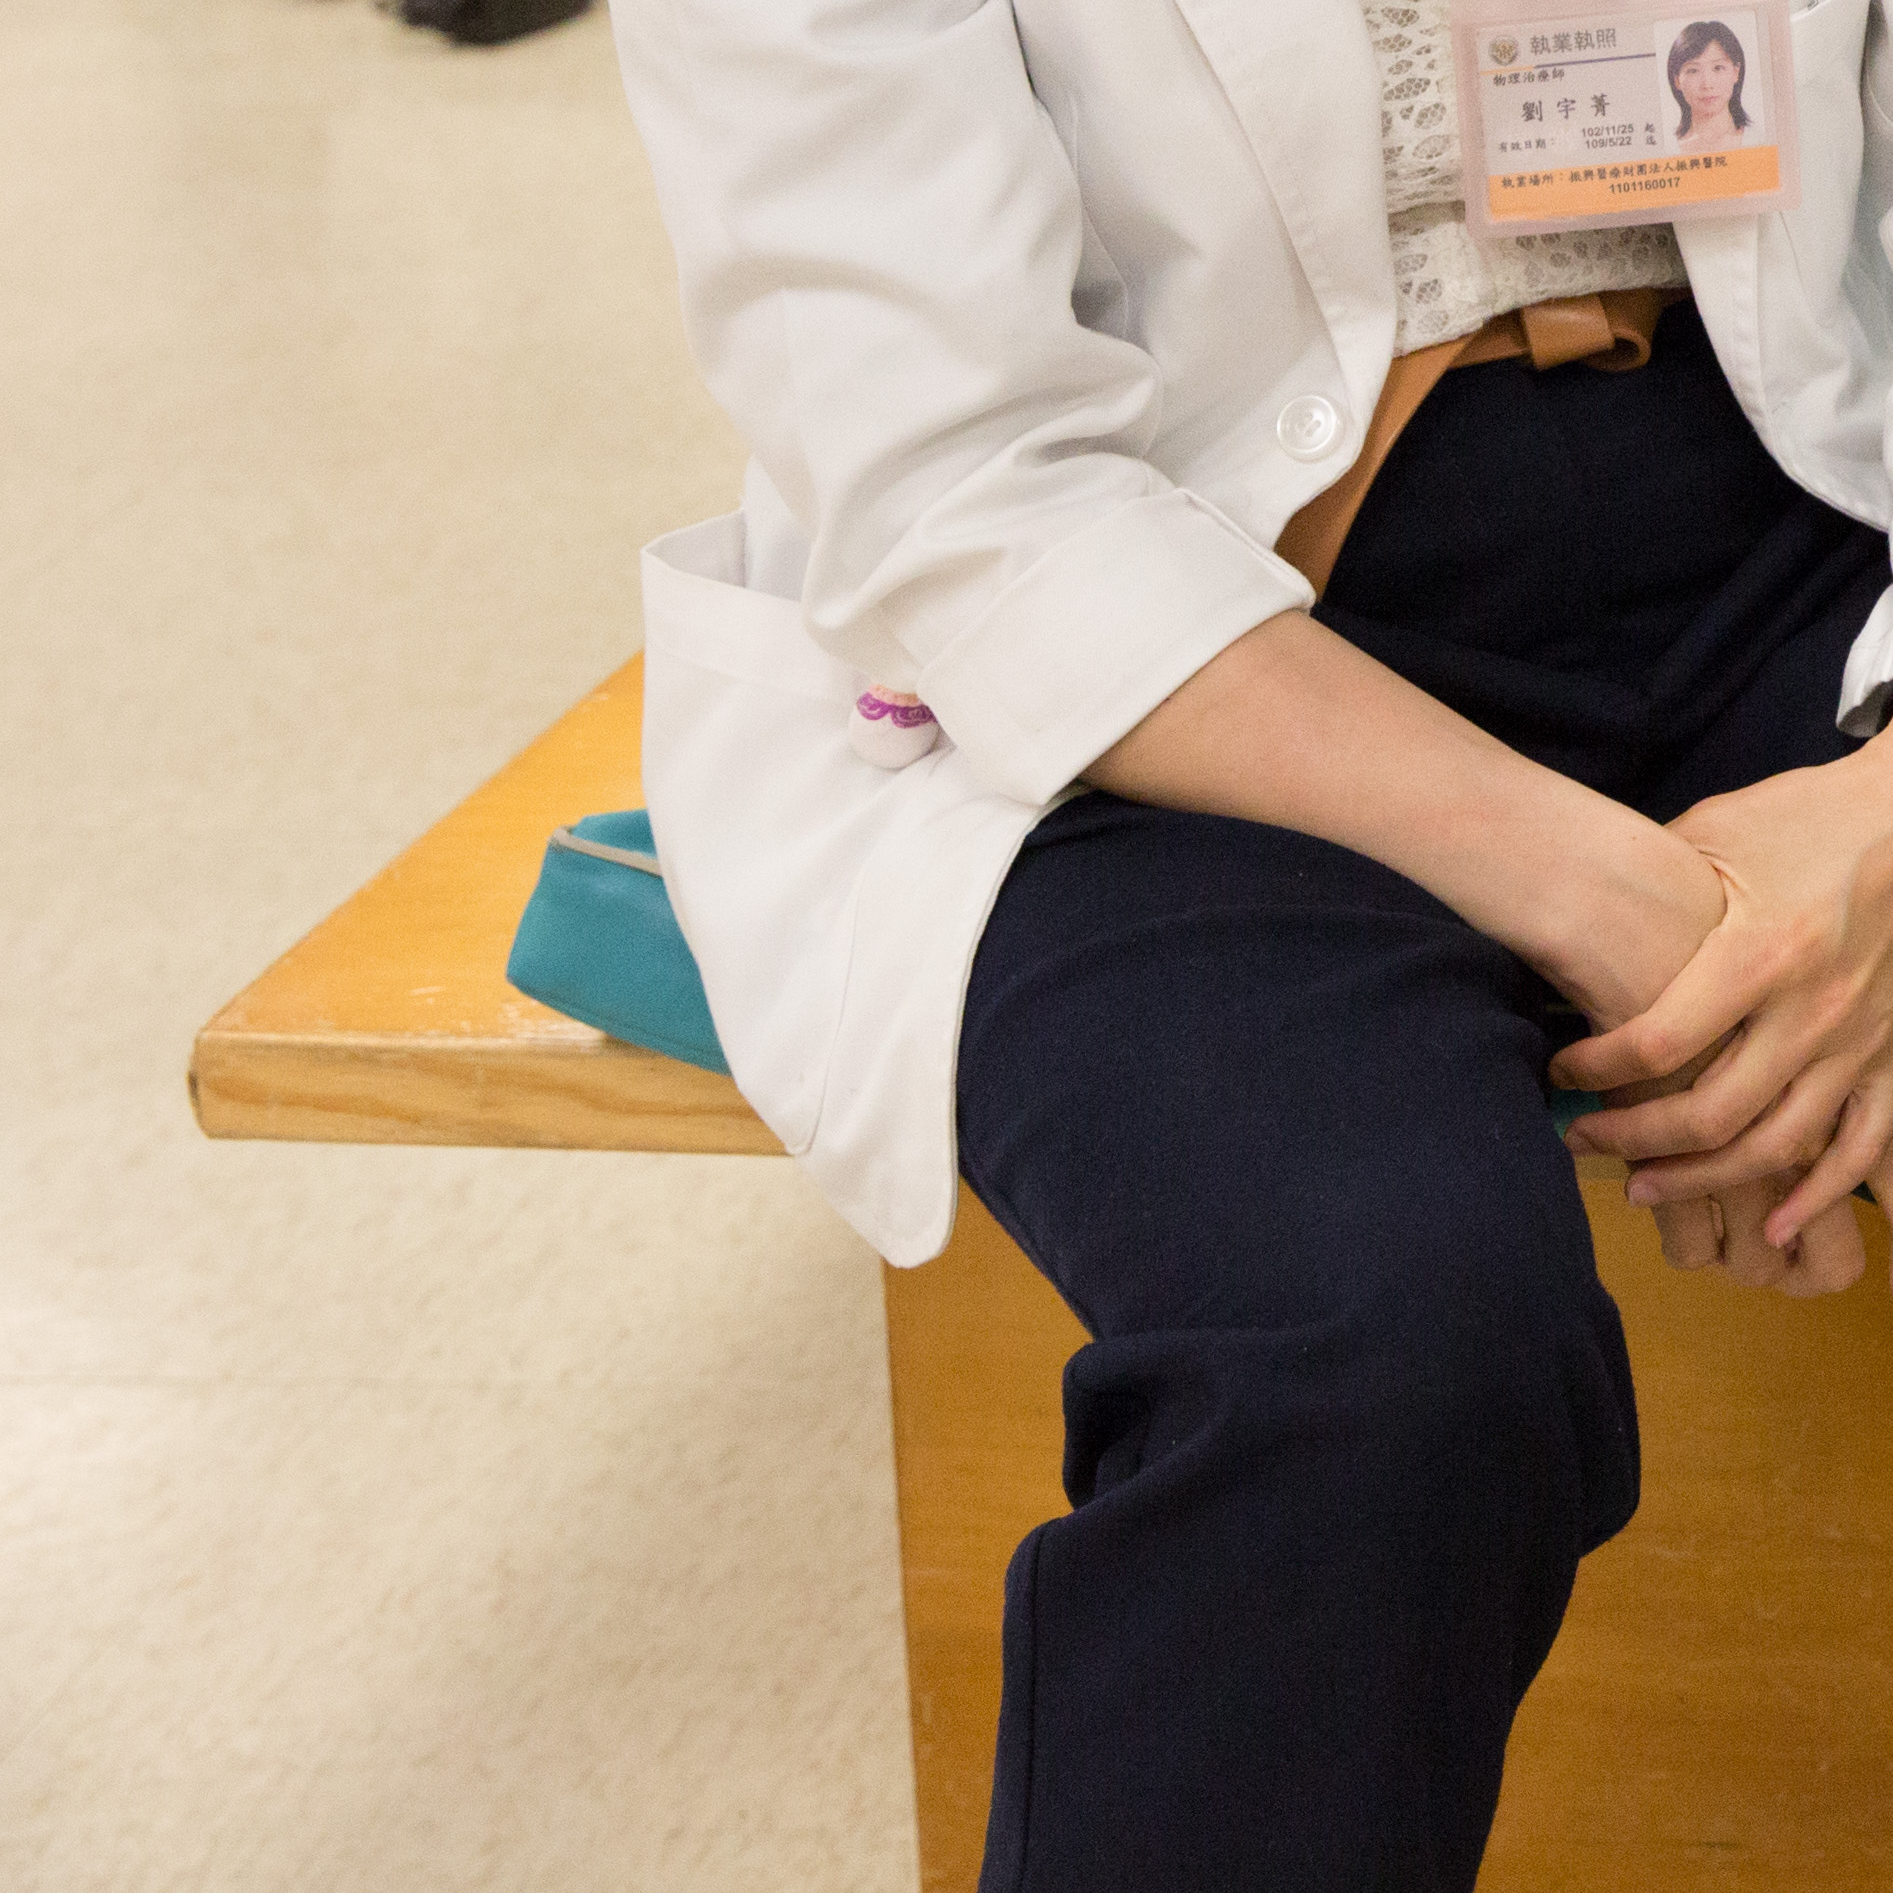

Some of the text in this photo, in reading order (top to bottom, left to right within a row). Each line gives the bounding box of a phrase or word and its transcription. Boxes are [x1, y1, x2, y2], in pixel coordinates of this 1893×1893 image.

[1529, 28, 1617, 56] 執業執照
[1493, 68, 1565, 86] 物理治療師
[1582, 123, 1634, 137] 102/11/25
[1586, 136, 1632, 149] 109/5/22
[1609, 177, 1680, 194] 1101160017
